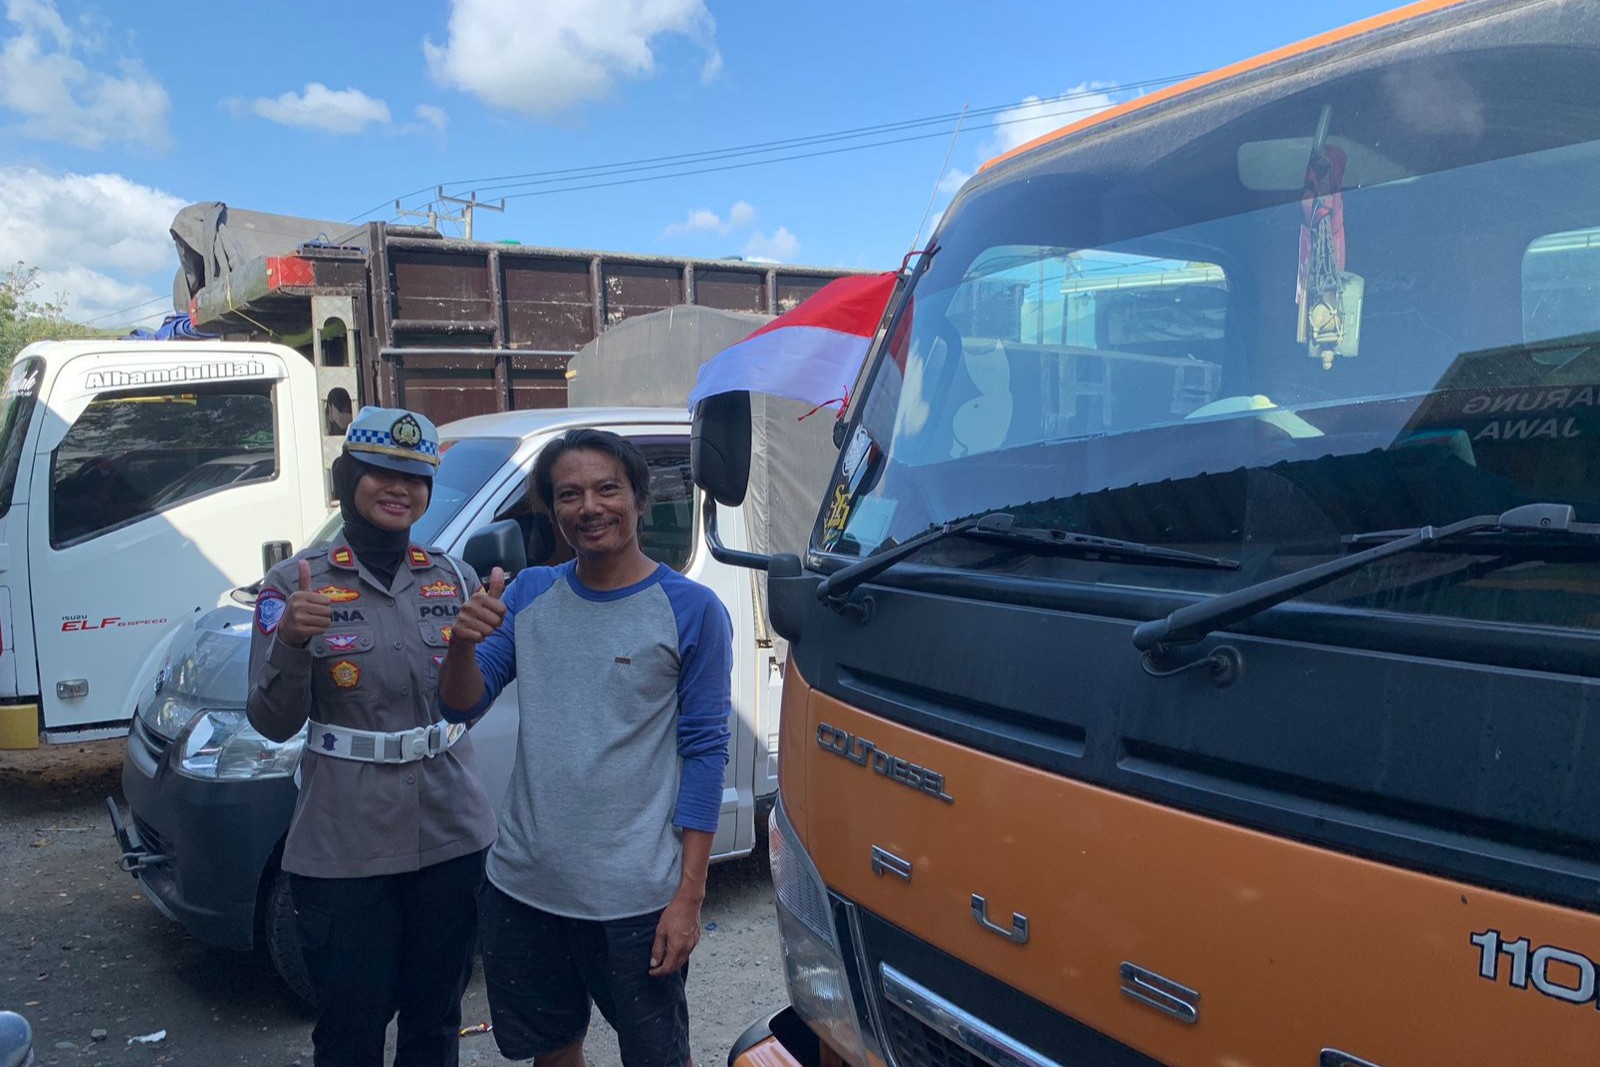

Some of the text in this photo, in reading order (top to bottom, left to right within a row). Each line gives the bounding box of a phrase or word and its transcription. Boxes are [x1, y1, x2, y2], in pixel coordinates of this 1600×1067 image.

[85, 361, 264, 389] Alhamdulillah
[61, 617, 121, 631] ELF
[816, 721, 955, 805] COLT DIESEL
